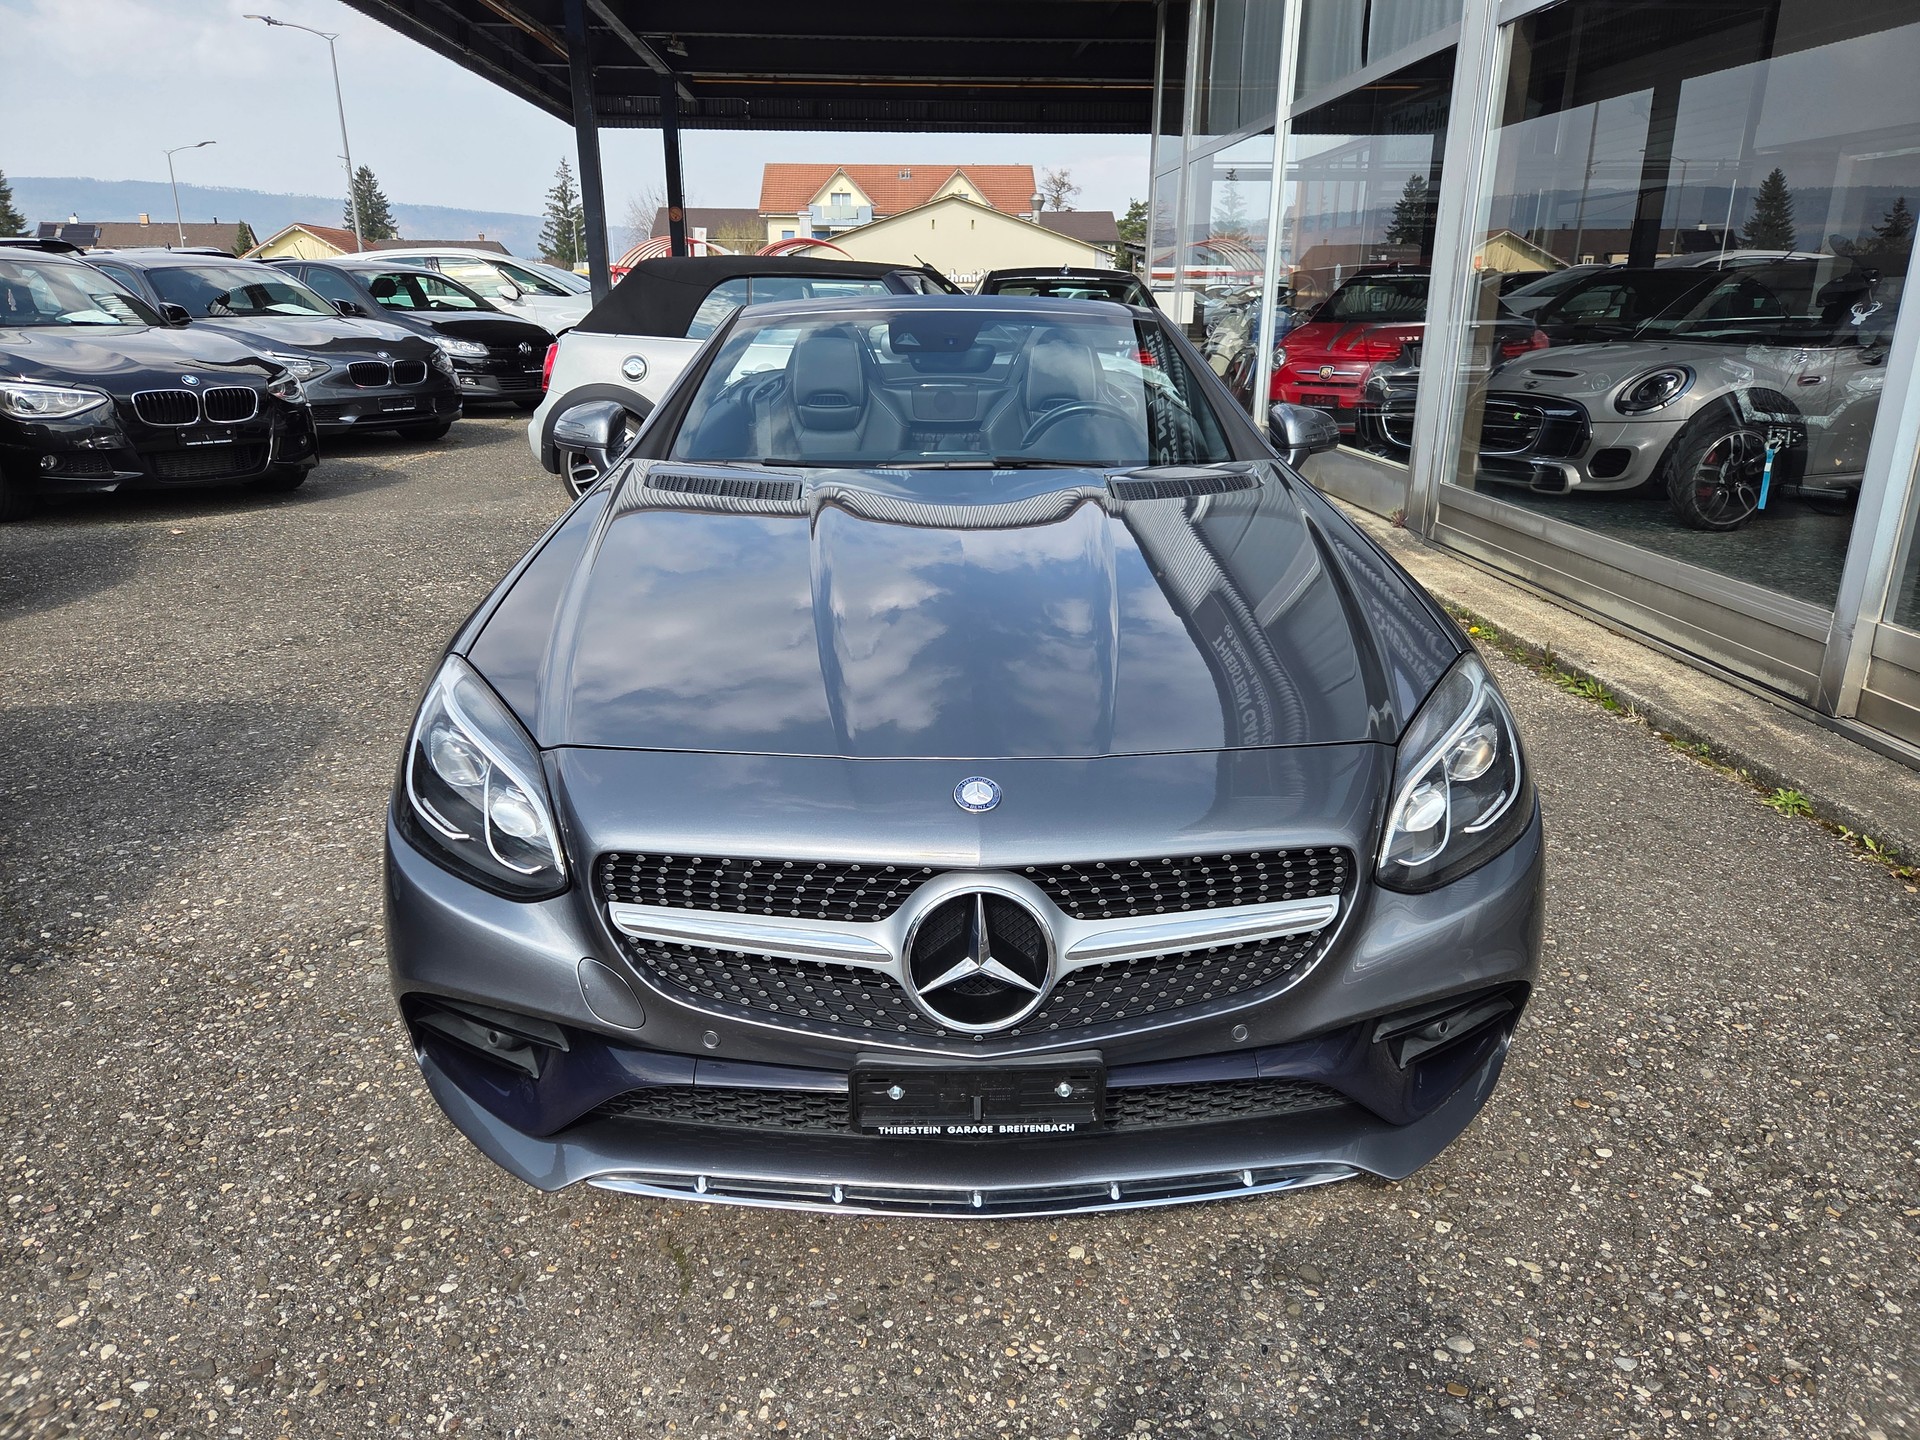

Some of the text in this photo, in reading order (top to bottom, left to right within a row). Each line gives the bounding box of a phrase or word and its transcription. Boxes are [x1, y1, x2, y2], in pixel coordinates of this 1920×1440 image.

[878, 1124, 1075, 1135] THIERSTEIN GARAGE BREITENBACH
